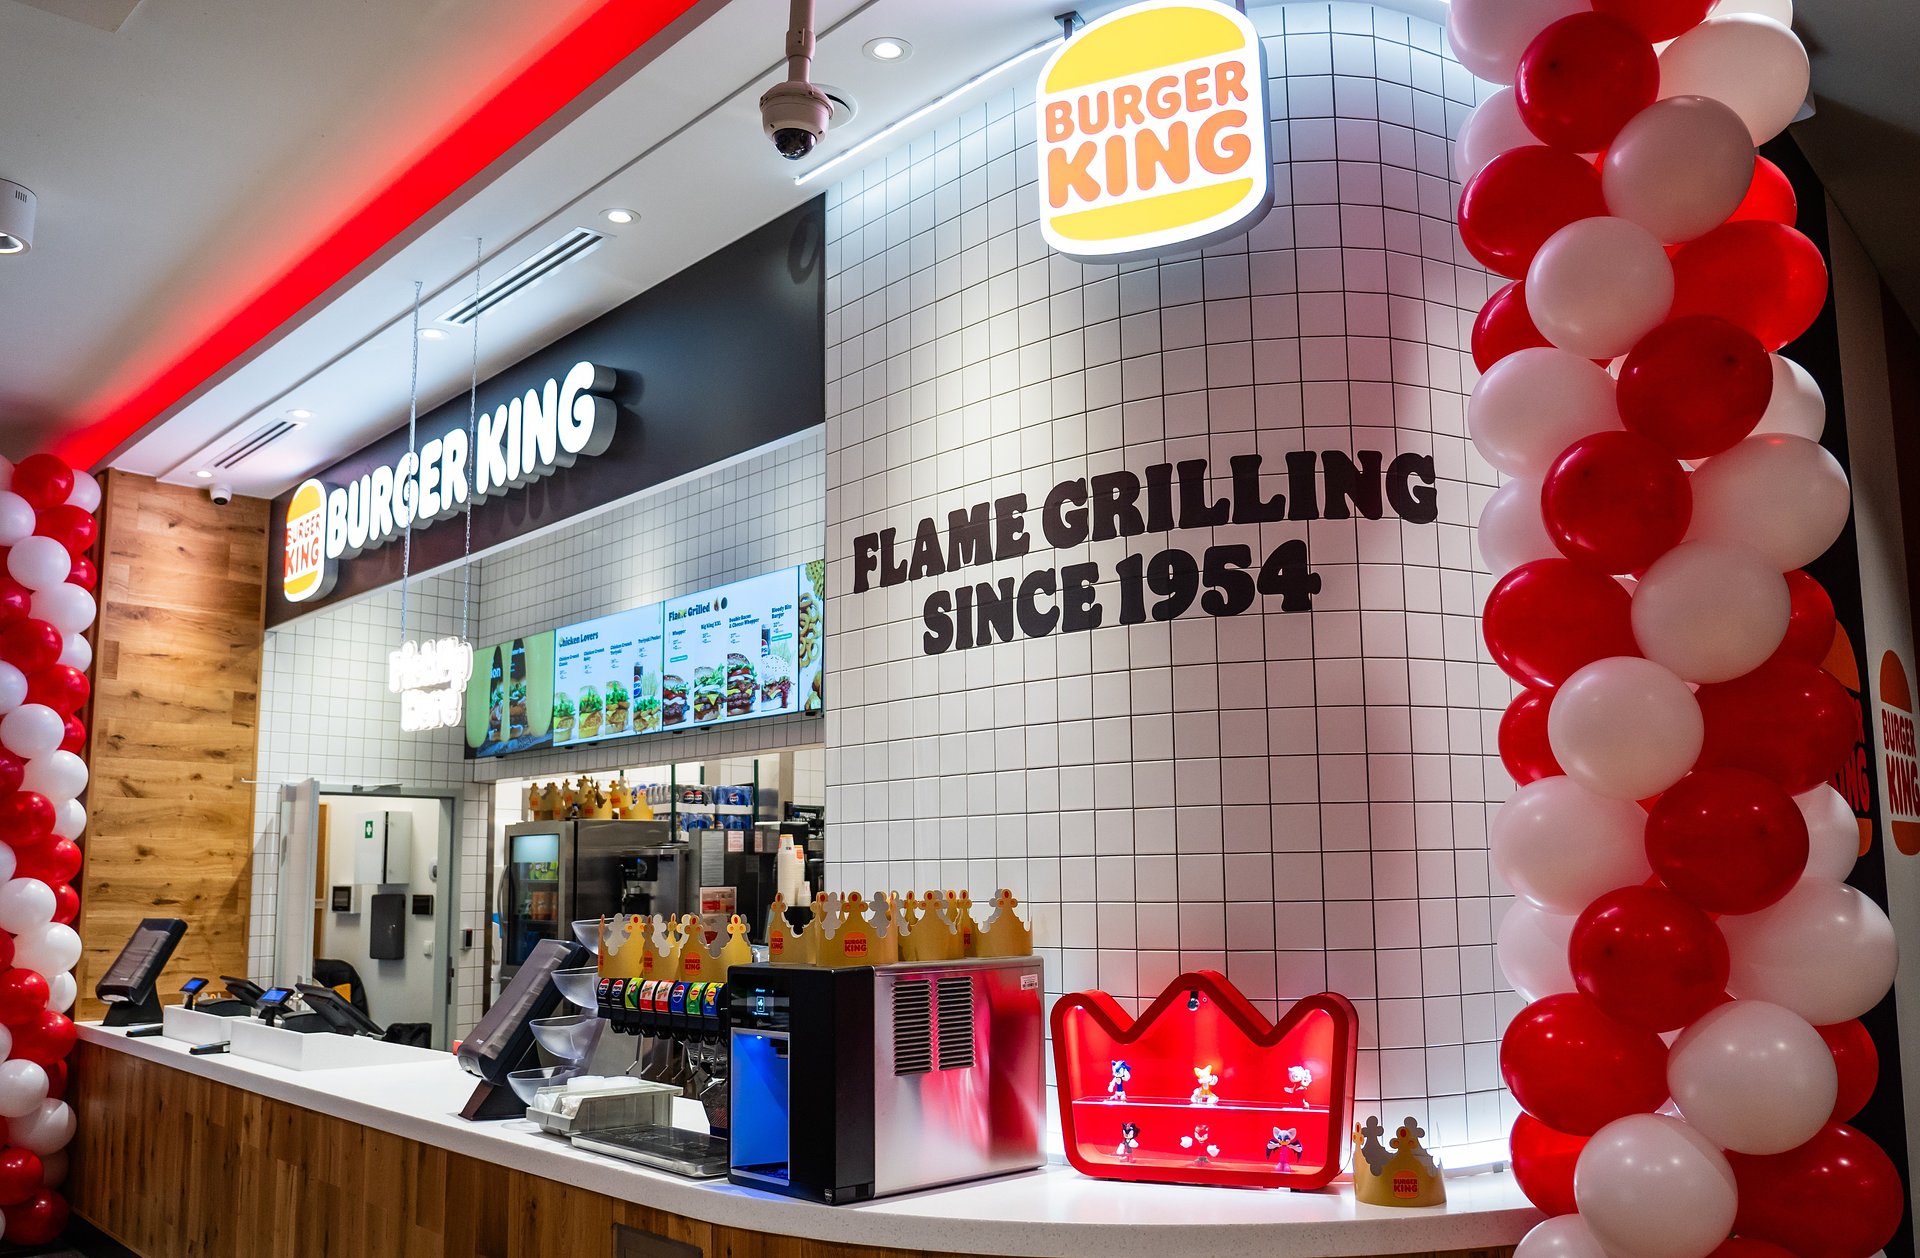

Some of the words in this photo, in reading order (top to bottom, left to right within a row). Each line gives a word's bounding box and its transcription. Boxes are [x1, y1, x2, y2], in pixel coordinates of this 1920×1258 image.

[1045, 60, 1249, 144] BURGER
[1047, 109, 1252, 209] KING
[325, 428, 468, 560] BURGER
[476, 361, 597, 495] KING
[284, 513, 321, 547] BURGER
[853, 492, 1030, 594] FLAME
[1042, 450, 1439, 549] GRILLING
[283, 536, 319, 578] KING
[687, 602, 710, 617] Grilled
[923, 561, 1103, 655] SINCE
[1115, 539, 1322, 625] 1954
[580, 632, 599, 643] Lovers
[1881, 708, 1917, 759] BURGER
[1885, 753, 1920, 818] KING
[844, 944, 867, 952] KING
[1393, 1185, 1418, 1193] KING
